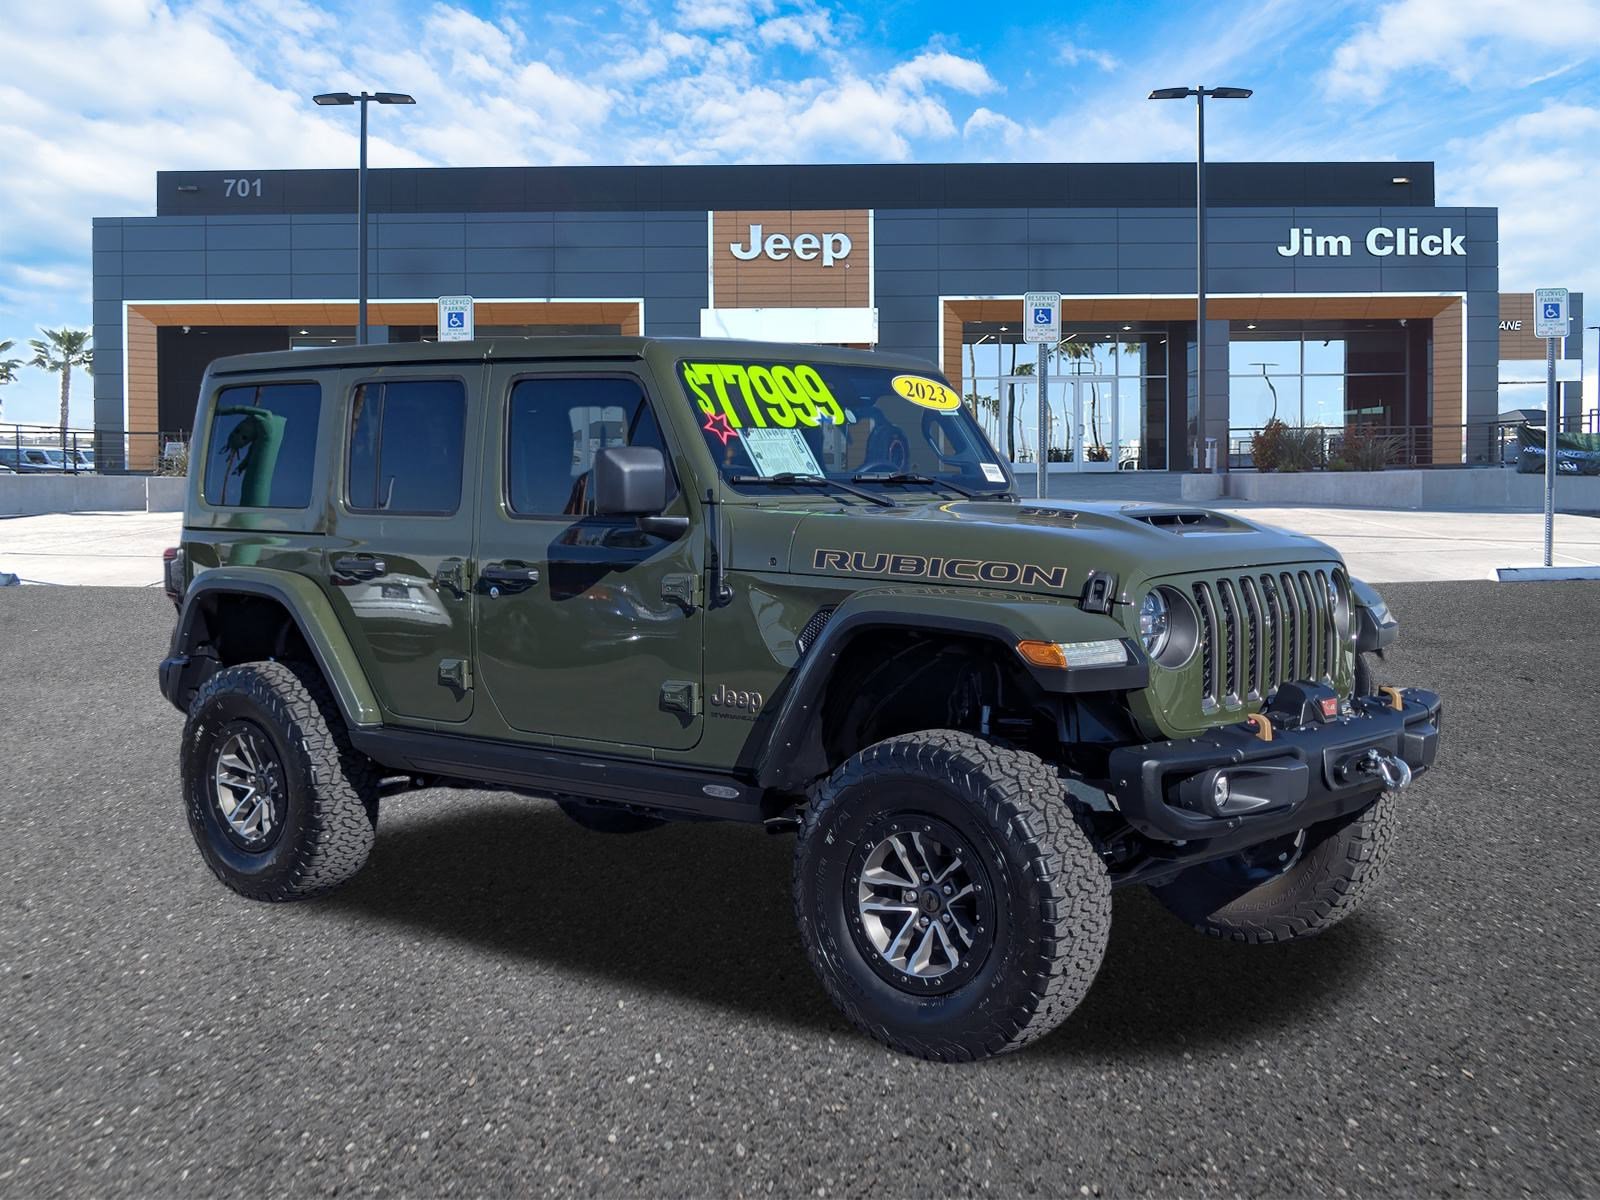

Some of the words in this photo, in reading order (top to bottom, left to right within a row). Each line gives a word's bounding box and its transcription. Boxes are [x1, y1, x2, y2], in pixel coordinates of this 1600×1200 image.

[223, 178, 262, 197] 701
[730, 224, 852, 268] Jeep
[1277, 228, 1352, 257] Jim
[1366, 227, 1467, 257] Click
[683, 362, 845, 428] $77999
[904, 380, 948, 404] 2023
[813, 548, 1068, 589] RUBICON
[711, 684, 763, 713] Jeep
